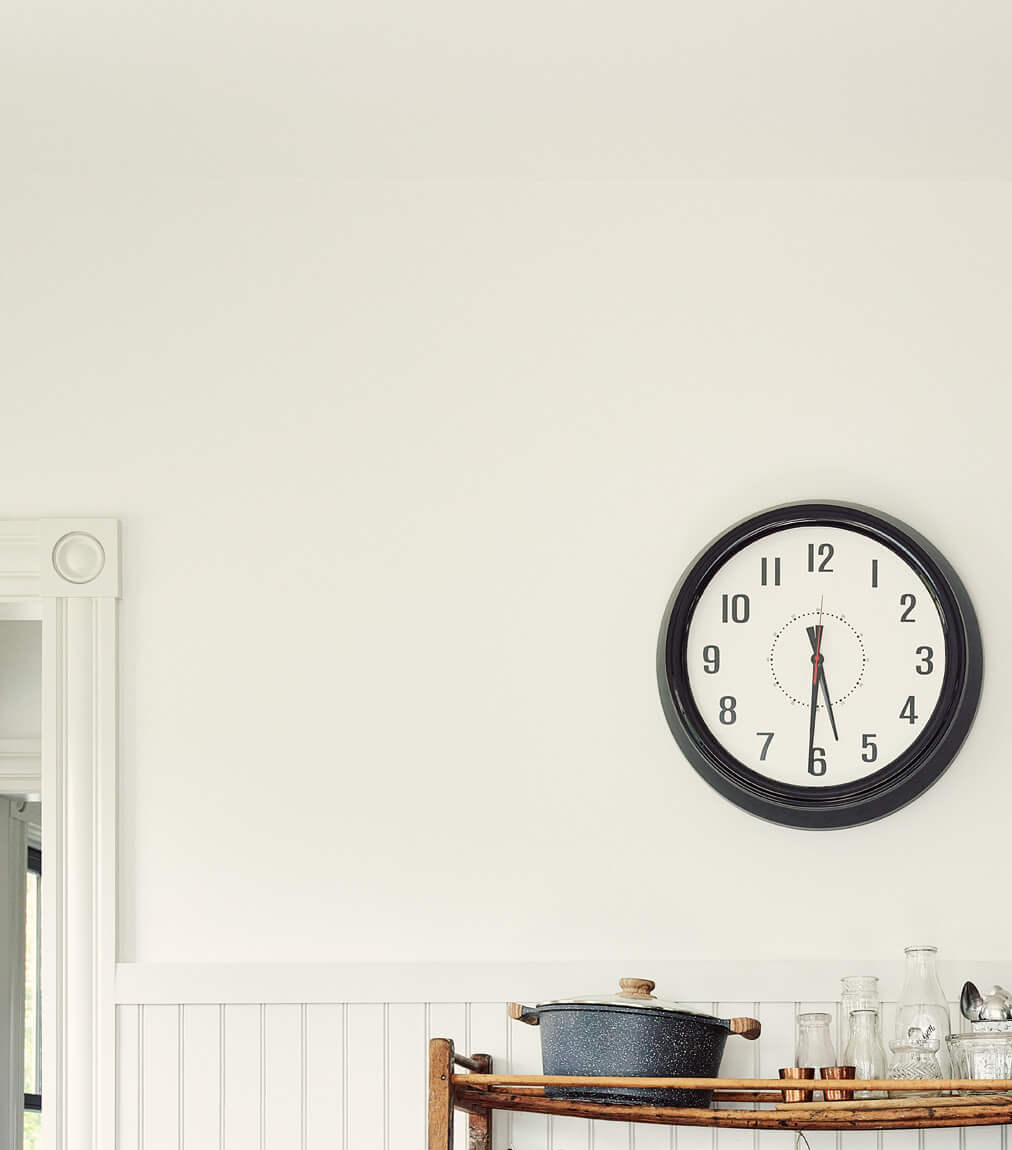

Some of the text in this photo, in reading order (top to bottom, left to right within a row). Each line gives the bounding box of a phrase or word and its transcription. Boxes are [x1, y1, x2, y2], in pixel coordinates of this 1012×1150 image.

[761, 557, 781, 586] 11
[808, 543, 835, 572] 12
[872, 559, 878, 588] 1
[721, 594, 750, 623] 10
[899, 594, 917, 622] 2
[702, 645, 720, 674] 9
[915, 646, 934, 675] 3
[719, 696, 737, 725] 8
[899, 696, 919, 724] 4
[756, 732, 774, 761] 7
[861, 734, 878, 762] 5
[810, 748, 828, 776] 6
